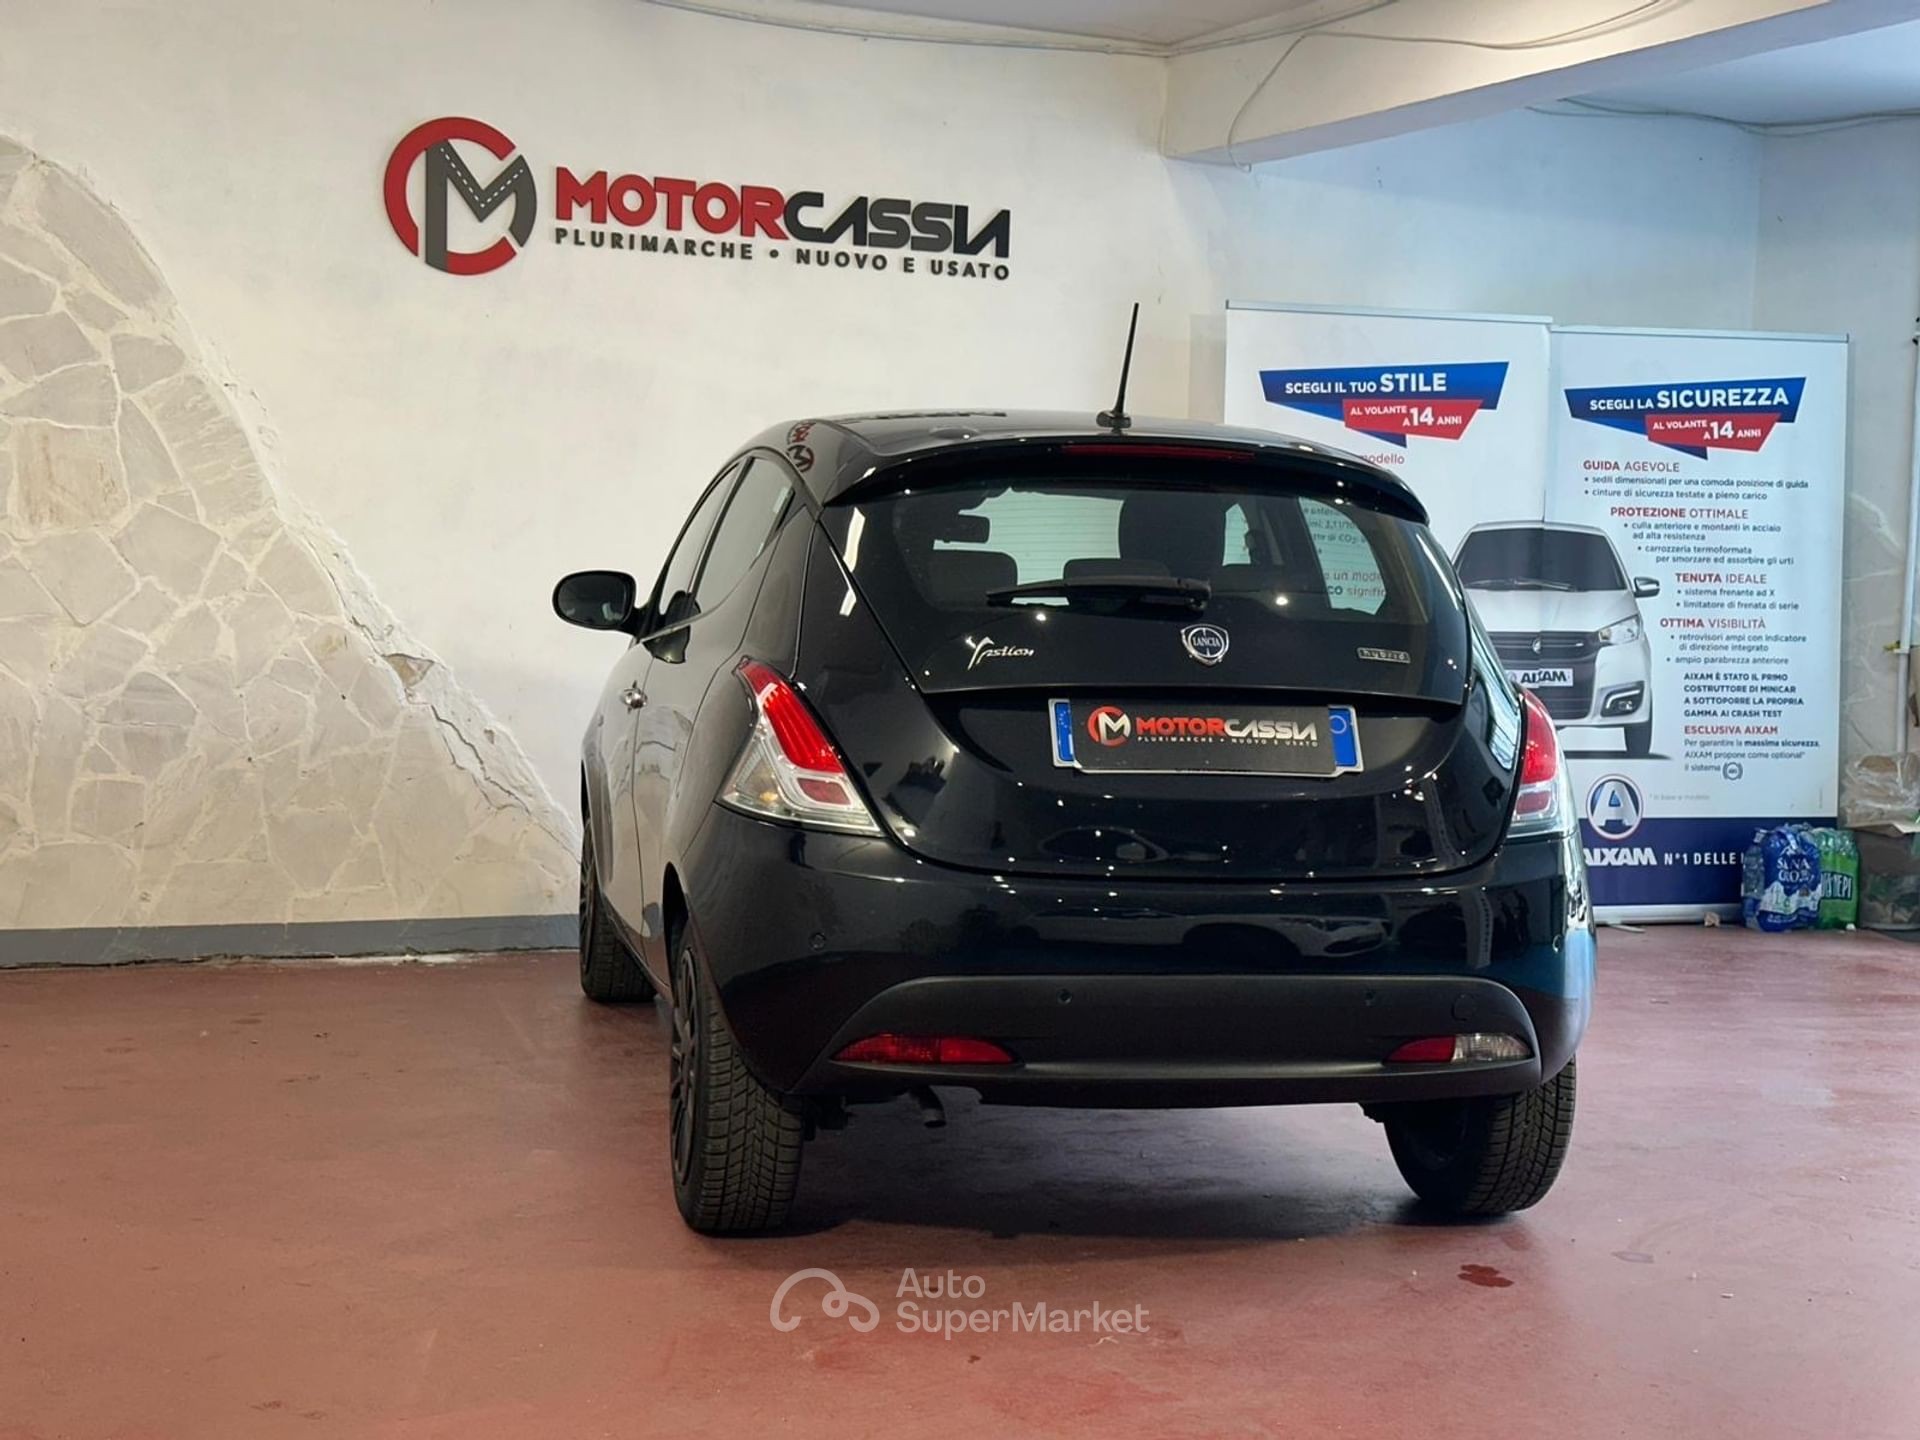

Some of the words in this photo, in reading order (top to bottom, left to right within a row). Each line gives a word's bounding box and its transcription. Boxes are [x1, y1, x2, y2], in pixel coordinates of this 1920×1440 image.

[555, 228, 753, 260] PLURIMARCHE
[795, 250, 888, 272] NUOVO
[903, 257, 915, 273] E
[930, 258, 1011, 281] USATO
[1285, 382, 1332, 394] SCEGLI
[1335, 382, 1346, 393] IL
[1349, 382, 1377, 393] TUO
[1380, 373, 1447, 393] STILE
[1590, 399, 1634, 410] SCEGLI
[1637, 399, 1654, 409] LA
[1657, 388, 1789, 408] SICUREZZA
[1350, 407, 1363, 416] AL
[1364, 405, 1407, 415] VOLANTE
[1402, 418, 1410, 426] A
[1409, 407, 1434, 426] 14
[1437, 415, 1462, 425] ANNI
[1653, 422, 1665, 430] AL
[1666, 420, 1707, 429] VOLANTE
[1703, 432, 1711, 440] A
[1710, 421, 1734, 439] 14
[1737, 429, 1761, 438] ANNI
[1583, 460, 1620, 471] GUIDA
[1624, 461, 1680, 473] AGEVOLE
[1592, 476, 1613, 484] sedili
[1614, 477, 1667, 486] dimensionati
[1668, 479, 1682, 488] per
[1701, 478, 1734, 487] comoda
[1736, 479, 1774, 489] posizione
[1776, 480, 1784, 488] di
[1785, 480, 1808, 490] guida
[1592, 489, 1621, 497] cinture
[1624, 489, 1632, 497] di
[1635, 489, 1674, 498] sicurezza
[1676, 490, 1705, 498] testate
[1715, 490, 1739, 500] pieno
[1742, 491, 1767, 500] carico
[1610, 507, 1686, 518] PROTEZIONE
[1689, 508, 1748, 519] OTTIMALE
[1632, 522, 1652, 530] culla
[1654, 522, 1691, 530] anteriore
[1702, 523, 1740, 531] montanti
[1752, 524, 1781, 532] acciaio
[1632, 532, 1644, 540] ad
[1646, 532, 1661, 540] alta
[1663, 532, 1706, 541] resistenza
[1645, 545, 1691, 553] carrozzeria
[1693, 545, 1752, 554] termoformata
[1656, 556, 1669, 564] per
[1713, 556, 1725, 564] ed
[1727, 556, 1764, 565] assorbire
[1767, 557, 1777, 566] gli
[1779, 557, 1794, 565] urti
[1675, 572, 1722, 583] TENUTA
[1725, 573, 1767, 584] IDEALE
[1684, 588, 1717, 596] sistema
[1719, 588, 1754, 597] frenante
[1756, 589, 1767, 597] ad
[1769, 589, 1775, 597] X
[1683, 601, 1724, 609] limitatore
[1727, 601, 1735, 609] di
[1737, 601, 1767, 610] frenata
[1768, 602, 1777, 610] di
[1778, 602, 1799, 610] serie
[1660, 618, 1705, 628] OTTIMA
[1708, 617, 1766, 629] VISIBILITÀ
[1192, 636, 1221, 648] LANCIA
[1679, 633, 1723, 641] retrovisori
[1725, 634, 1746, 643] ampi
[1765, 634, 1807, 642] indicatore
[965, 636, 1035, 670] Ypsilon
[1679, 643, 1687, 651] di
[1689, 643, 1729, 651] direzione
[1731, 643, 1769, 653] integrato
[1675, 656, 1702, 665] ampio
[1703, 656, 1750, 665] parabrezza
[1751, 656, 1789, 665] anteriore
[1684, 673, 1713, 681] AIXAM
[1723, 673, 1750, 681] STATO
[1751, 673, 1759, 681] IL
[1761, 673, 1788, 681] PRIMO
[1684, 685, 1747, 693] COSTRUTTORE
[1749, 685, 1758, 693] DI
[1760, 685, 1796, 693] MINICAR
[1684, 697, 1691, 705] A
[1693, 697, 1751, 705] SOTTOPORRE
[1753, 697, 1765, 705] LA
[1766, 697, 1804, 706] PROPRIA
[1684, 709, 1718, 717] GAMMA
[1720, 709, 1729, 717] AI
[1731, 709, 1760, 718] CRASH
[1762, 709, 1782, 718] TEST
[1684, 725, 1742, 735] ESCLUSIVA
[1744, 725, 1778, 735] AIXAM
[1699, 739, 1734, 748] garantire
[1744, 739, 1779, 747] massima
[1684, 751, 1712, 759] AIXAM
[1714, 752, 1746, 760] propone
[1693, 852, 1737, 865] DELLE
